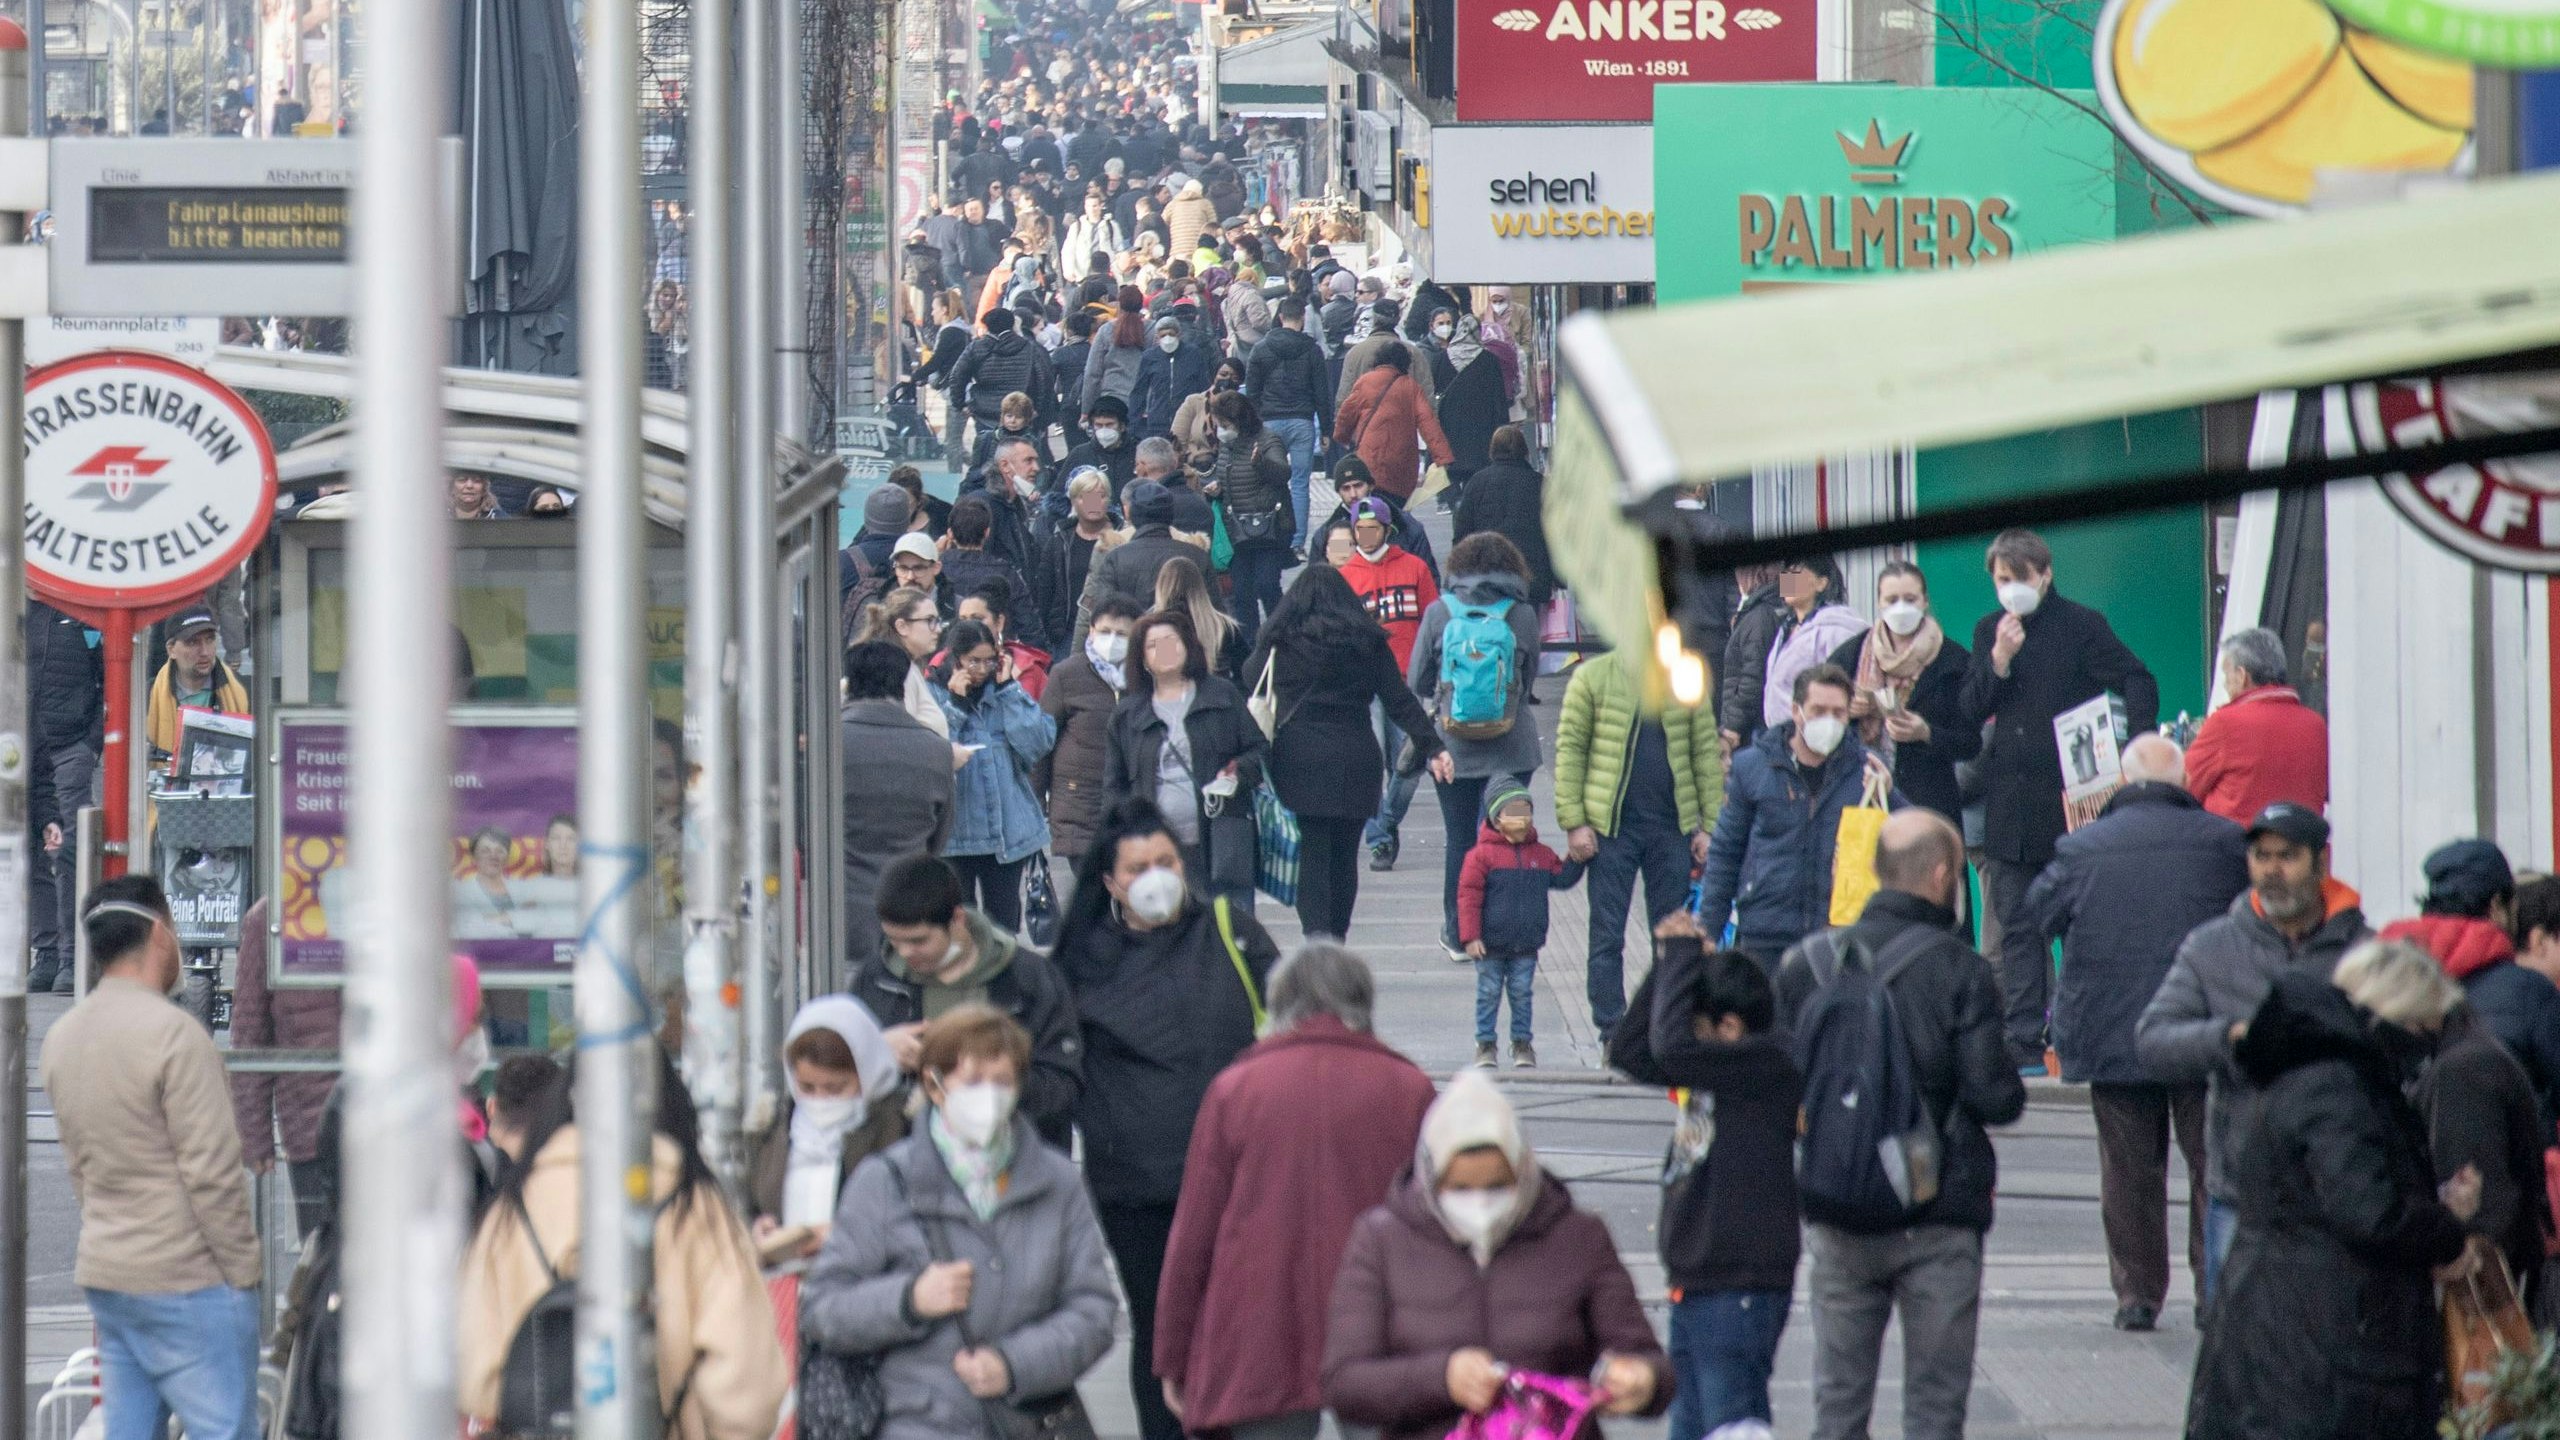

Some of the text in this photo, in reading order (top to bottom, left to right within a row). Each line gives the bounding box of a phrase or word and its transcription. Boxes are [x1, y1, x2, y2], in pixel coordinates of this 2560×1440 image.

[1545, 0, 1727, 41] ANKER
[1584, 60, 1689, 76] Wien 1891
[101, 170, 139, 183] Linie
[266, 169, 323, 183] Abfahrt
[1490, 171, 1596, 203] sehen!
[168, 226, 340, 248] bitte beachten
[1739, 194, 2014, 271] PALMERS
[51, 318, 169, 334] Reumannplatz
[296, 795, 333, 812] Seit
[197, 893, 239, 923] Porträt!
